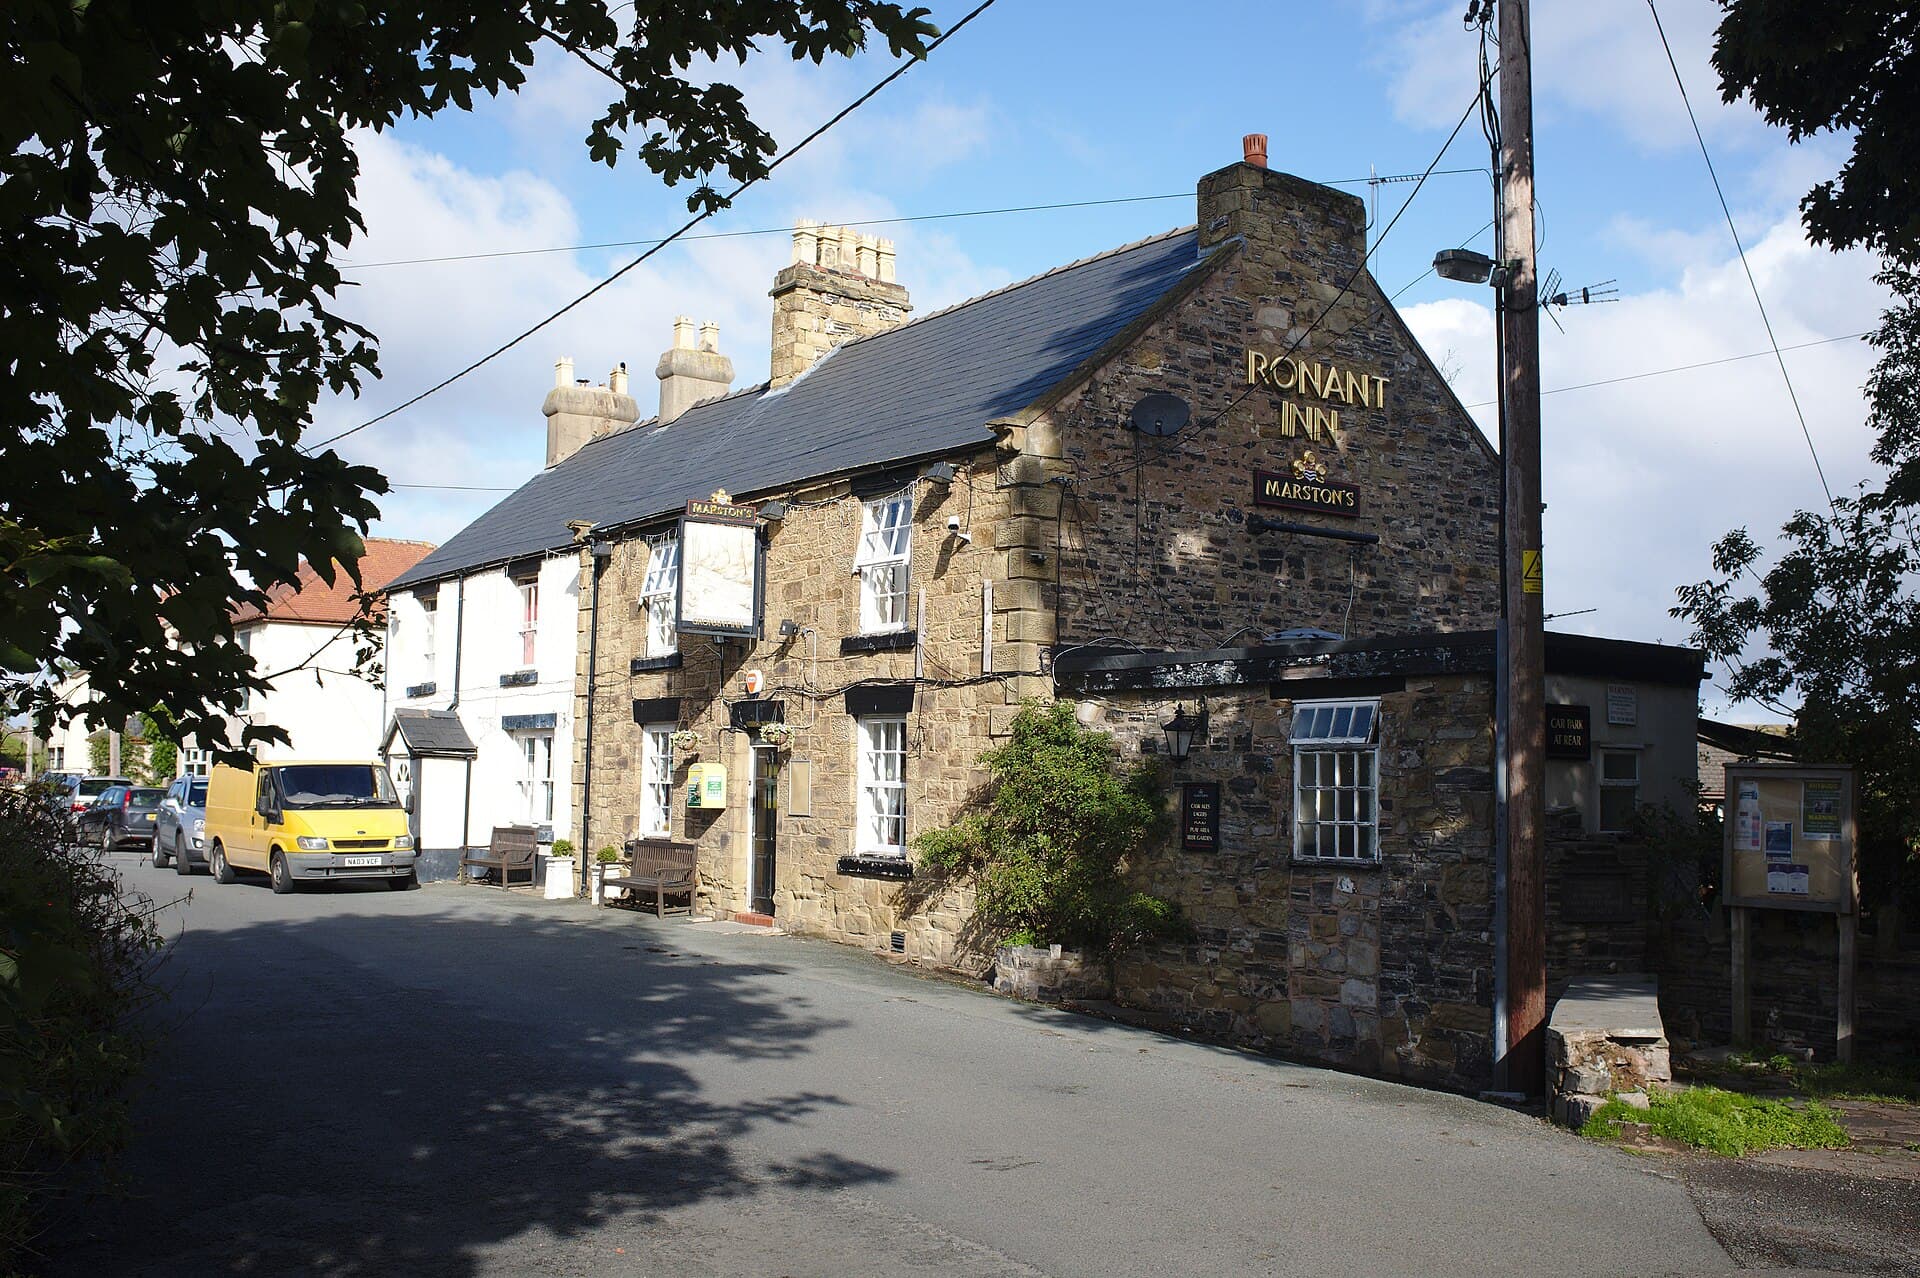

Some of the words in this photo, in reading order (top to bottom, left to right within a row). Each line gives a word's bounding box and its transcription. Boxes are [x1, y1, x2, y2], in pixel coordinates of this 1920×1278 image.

[1248, 350, 1390, 408] RONANT
[1281, 400, 1338, 444] INN
[1265, 479, 1354, 507] MARSTON'S
[692, 502, 752, 518] MARSTON'S
[1550, 718, 1565, 729] CAR
[1567, 719, 1584, 730] PARK
[1553, 734, 1562, 745] AT
[1563, 735, 1581, 746] REAR
